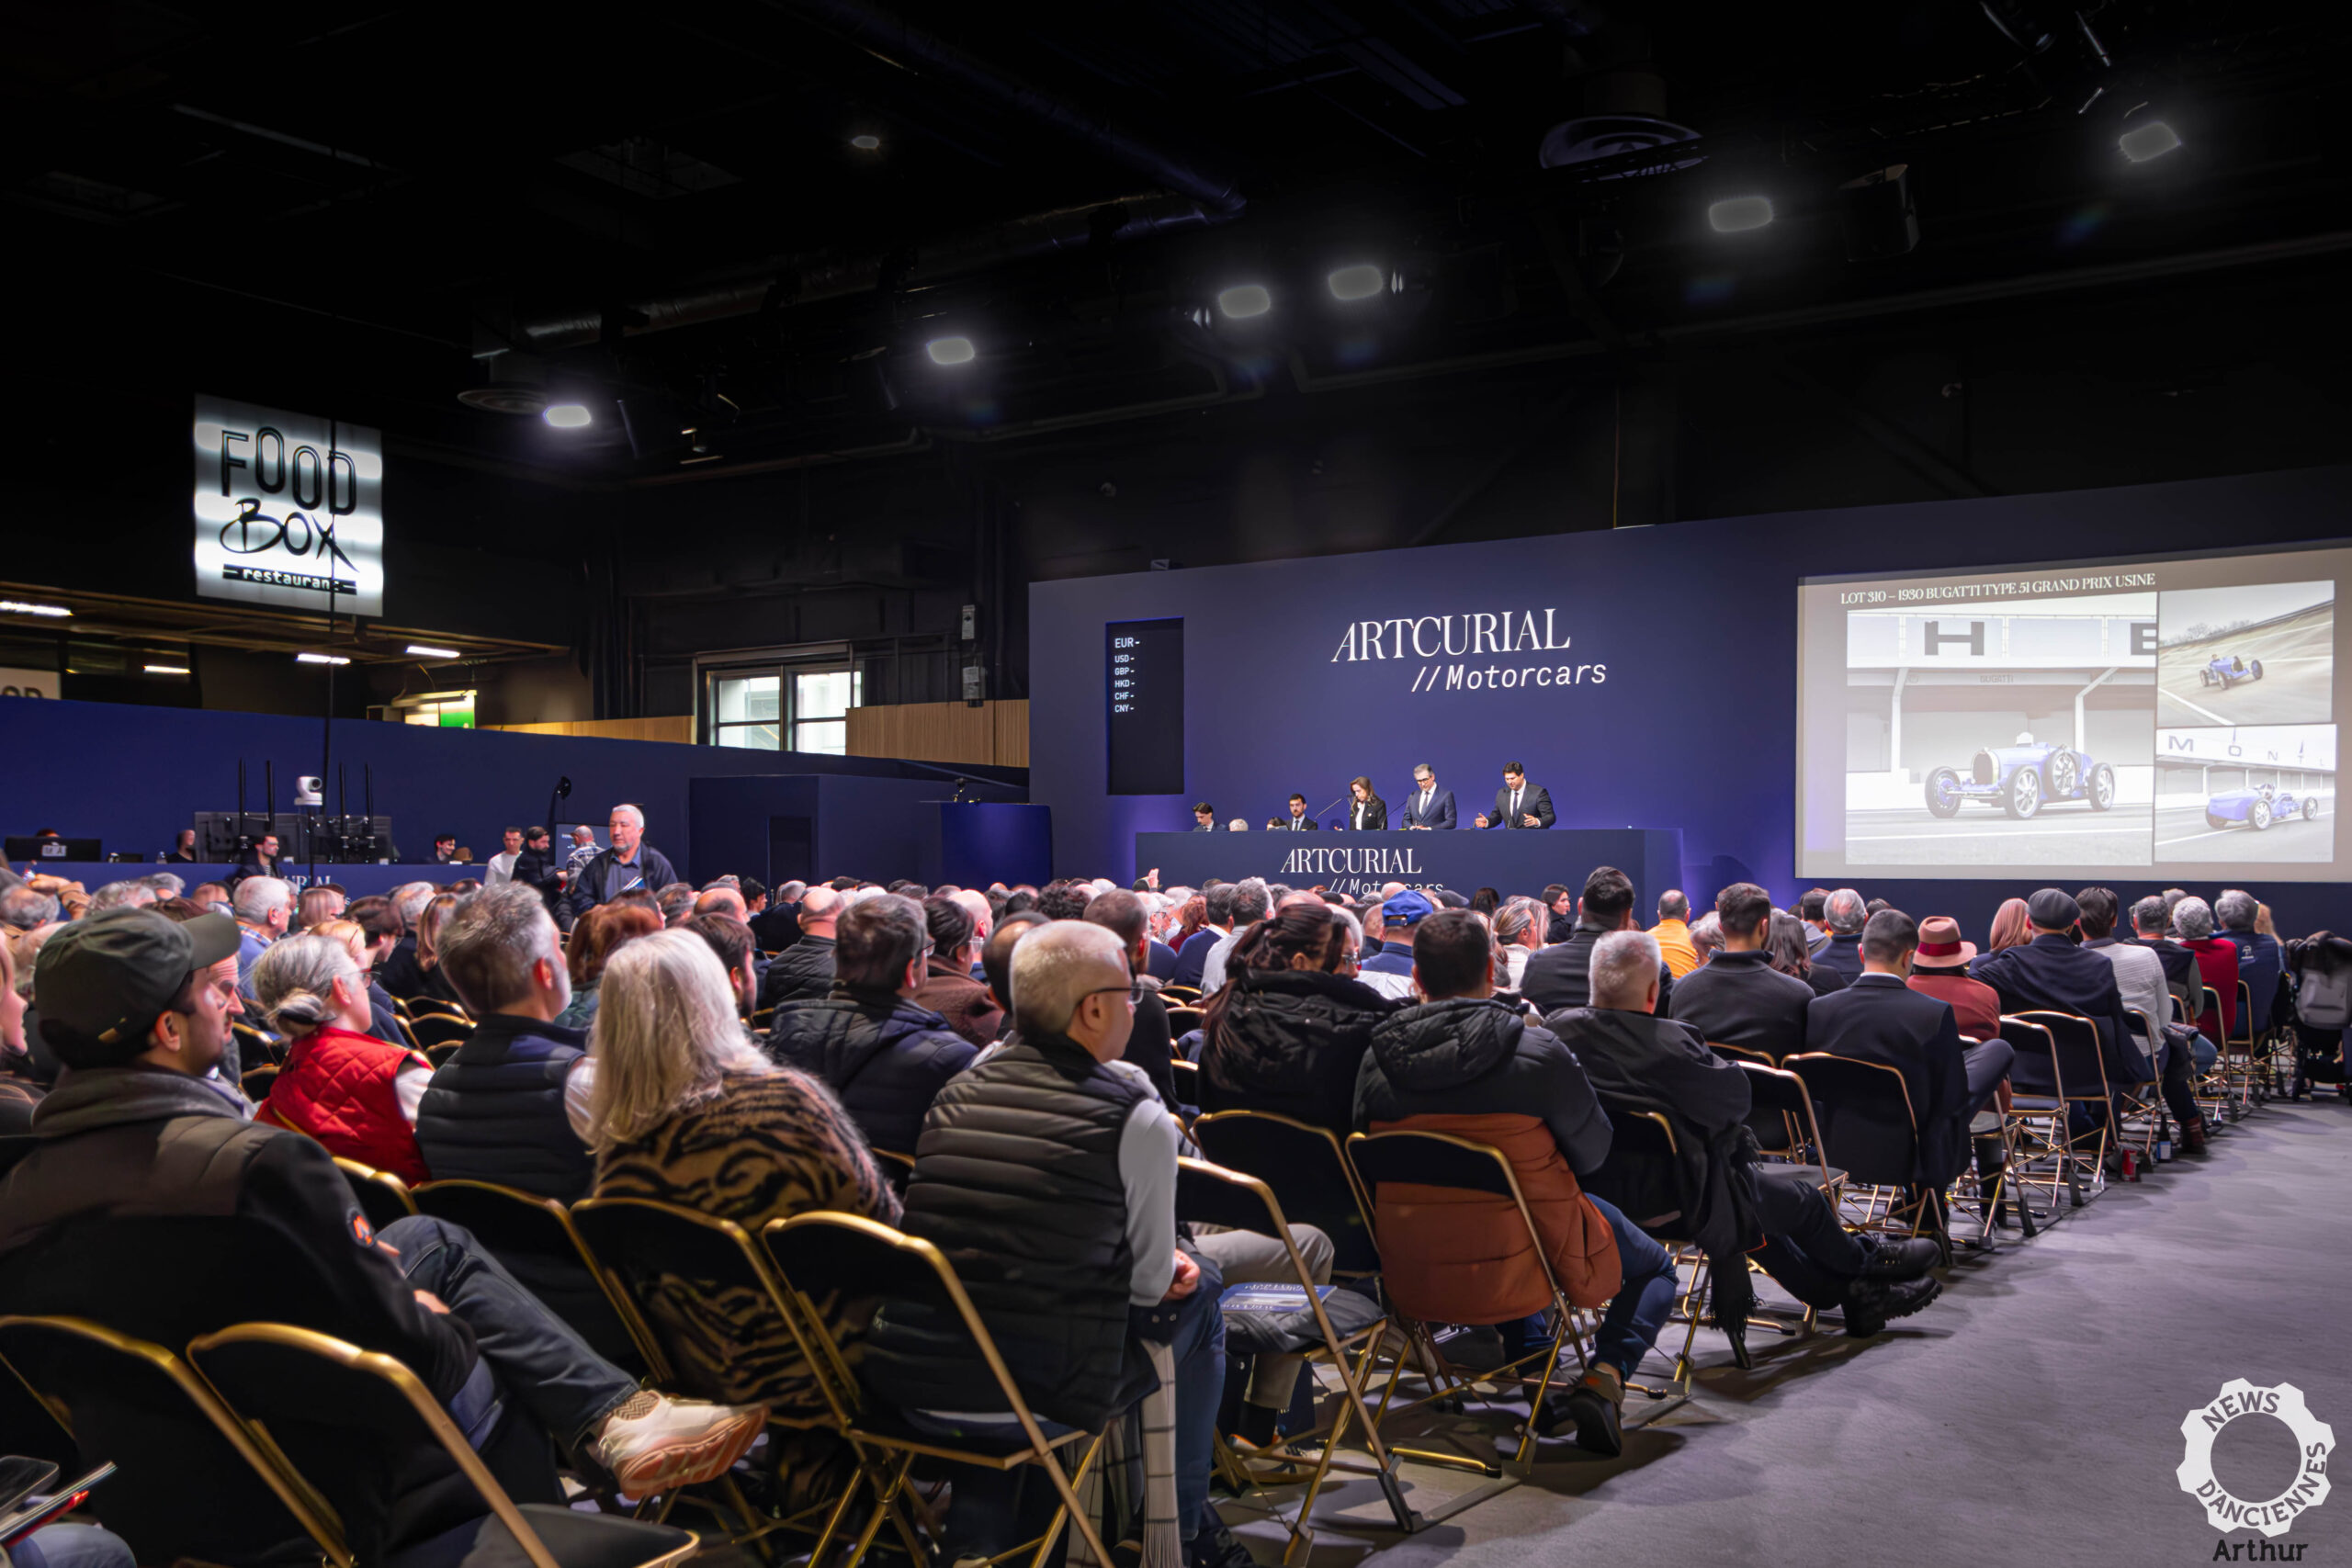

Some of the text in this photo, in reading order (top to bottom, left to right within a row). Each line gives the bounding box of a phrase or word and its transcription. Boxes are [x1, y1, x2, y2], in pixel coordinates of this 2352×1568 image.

[221, 426, 356, 515] FOOD
[220, 498, 360, 573] BOX
[1840, 592, 1866, 604] LOT
[1867, 591, 1886, 603] 310
[1898, 588, 1924, 601] 1930
[1926, 584, 1980, 599] BUGATTI
[1983, 582, 2017, 596] TYPE
[2018, 581, 2030, 593] 51
[2032, 579, 2080, 592] GRAND
[2082, 576, 2112, 590] PRIX
[2115, 573, 2155, 588] USINE
[1330, 608, 1571, 662] ARTCURIAL
[1280, 848, 1422, 874] ARTCURIAL
[1329, 878, 1444, 896] //Motars
